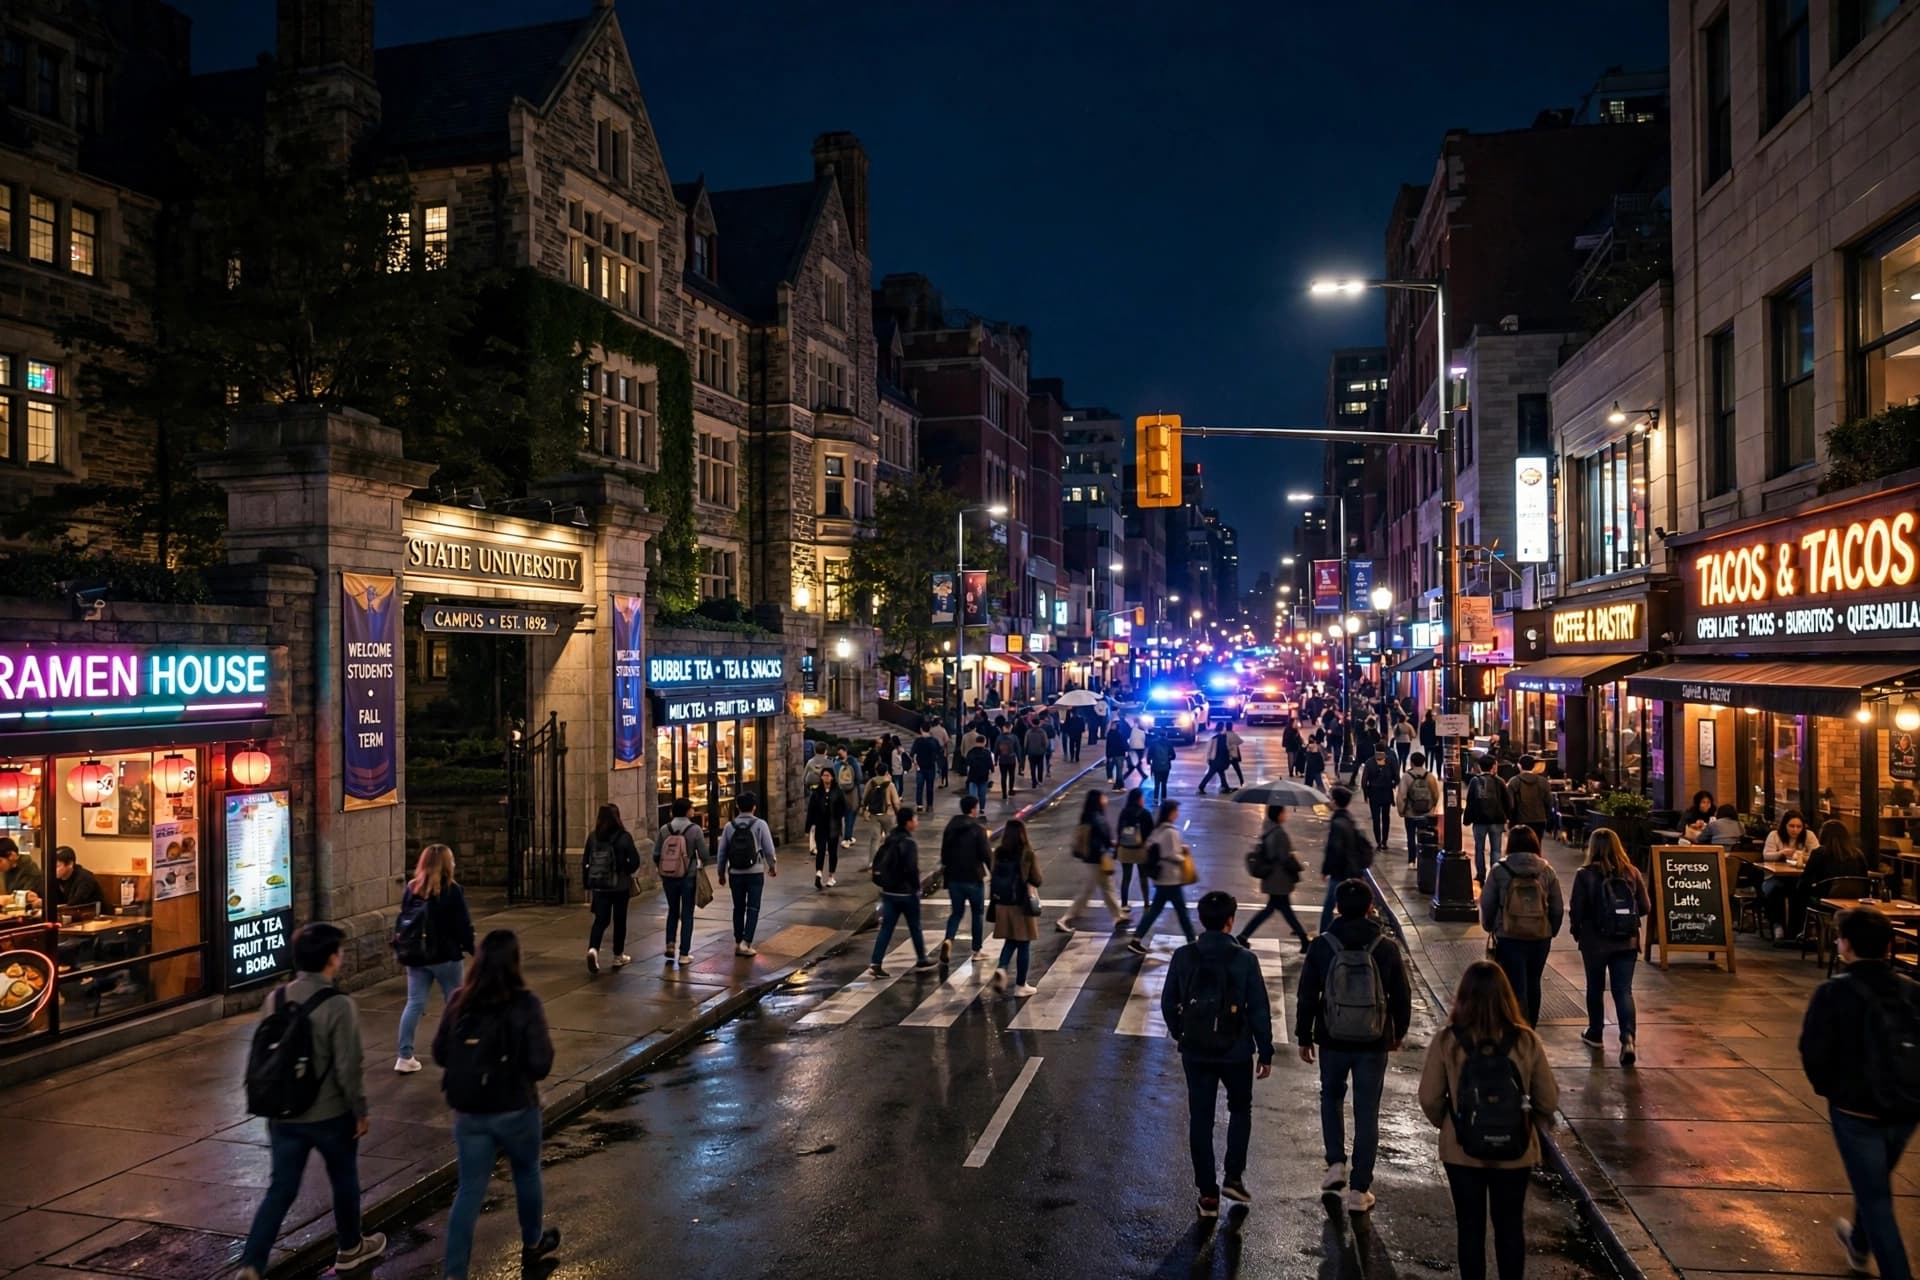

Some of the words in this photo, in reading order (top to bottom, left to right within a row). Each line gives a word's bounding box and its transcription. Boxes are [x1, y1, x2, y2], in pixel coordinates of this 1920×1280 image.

[409, 539, 472, 571] STATE
[478, 547, 578, 581] UNIVERSITY
[1696, 544, 1767, 606] TACOS
[1776, 543, 1795, 597] &
[1801, 511, 1915, 594] TACOS
[434, 611, 484, 628] CAMPUS
[500, 615, 520, 629] EST.
[525, 617, 547, 630] 1892
[1553, 611, 1586, 644] COFFEE
[1587, 609, 1595, 641] &
[1596, 604, 1637, 641] PASTRY
[1697, 616, 1718, 639] OPEN
[1718, 615, 1739, 638] LATE
[1747, 612, 1775, 637] TACOS
[1786, 608, 1834, 635] BURRITOS
[1847, 601, 1920, 634] QUESADILLA
[348, 641, 392, 658] WELCOME
[0, 655, 138, 700] RAMEN
[151, 654, 267, 696] HOUSE
[347, 662, 393, 680] STUDENTS
[651, 660, 692, 682] BUBBLE
[694, 660, 714, 680] TEA
[722, 660, 741, 680] TEA
[742, 660, 749, 679] &
[751, 660, 782, 679] SNACKS
[358, 709, 381, 725] FALL
[669, 703, 690, 720] MILK
[690, 702, 706, 718] TEA
[715, 700, 737, 717] FRUIT
[736, 699, 749, 715] TEA
[756, 698, 775, 713] BOBA
[358, 732, 384, 749] TERM
[1666, 858, 1710, 875] Espresso
[1673, 892, 1701, 907] Latte
[233, 924, 260, 940] MILK
[263, 916, 283, 934] TEA
[233, 938, 263, 960] FRUIT
[265, 934, 285, 953] TEA
[245, 953, 276, 975] BOBA
